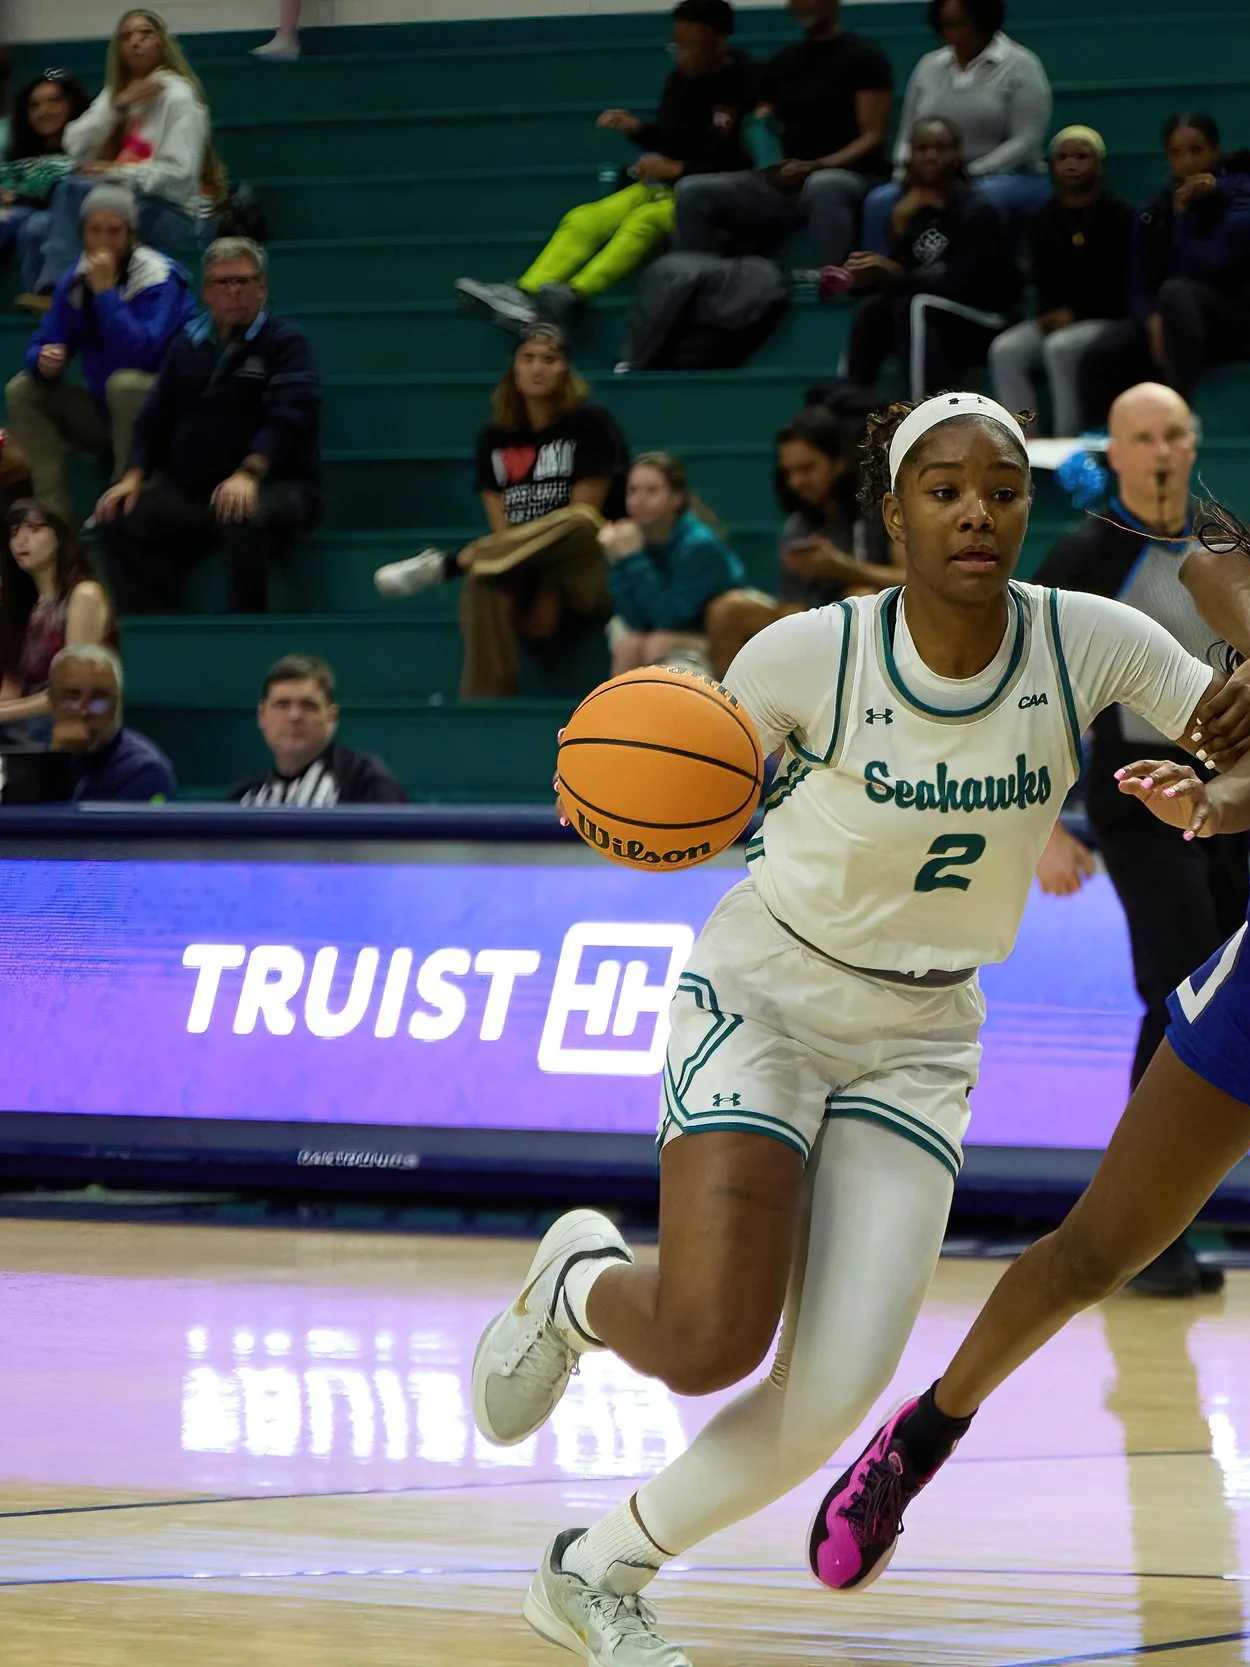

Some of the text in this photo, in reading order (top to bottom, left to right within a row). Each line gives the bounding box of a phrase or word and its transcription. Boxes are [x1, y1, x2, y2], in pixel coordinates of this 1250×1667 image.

[1018, 692, 1048, 710] CAA
[864, 753, 1052, 813] Seahawks
[576, 808, 712, 864] Wilson
[914, 833, 987, 893] 2
[182, 943, 542, 1043] TRUIST
